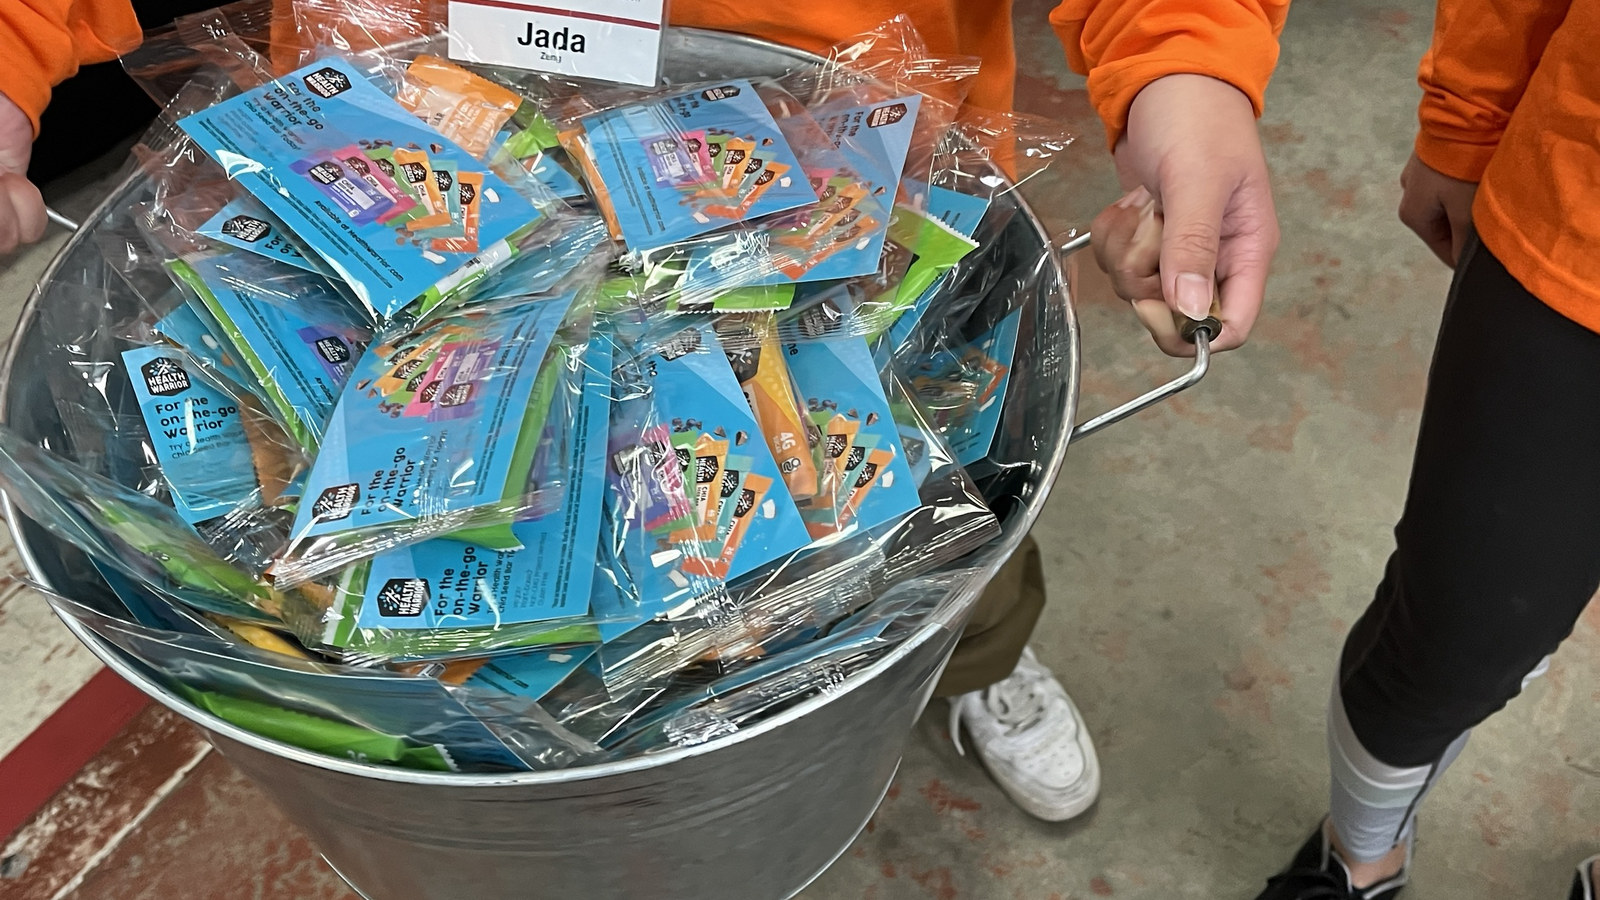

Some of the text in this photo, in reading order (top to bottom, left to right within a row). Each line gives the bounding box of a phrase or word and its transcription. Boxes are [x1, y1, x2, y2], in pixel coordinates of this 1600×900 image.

[517, 22, 586, 53] Jada
[312, 72, 339, 94] HEALTH
[274, 88, 324, 130] on-the-go
[287, 82, 321, 112] For the
[853, 111, 864, 123] For
[264, 236, 282, 250] For
[147, 372, 186, 386] HEALTH
[150, 380, 188, 394] WARRIOR
[155, 397, 208, 414] For he
[160, 406, 236, 427] on-he-go
[168, 443, 183, 452] Try
[780, 432, 796, 450] 4G
[378, 447, 406, 512] on-the-go
[697, 458, 707, 482] HEALTH
[361, 470, 384, 516] For the
[393, 460, 416, 508] Warrior
[329, 486, 348, 518] HEALTH
[434, 568, 455, 616] For the
[452, 546, 477, 616] on-the-go
[492, 568, 502, 592] Health
[501, 576, 510, 594] Seed
[398, 581, 416, 615] HEALTH
[409, 580, 426, 615] WARRIOR
